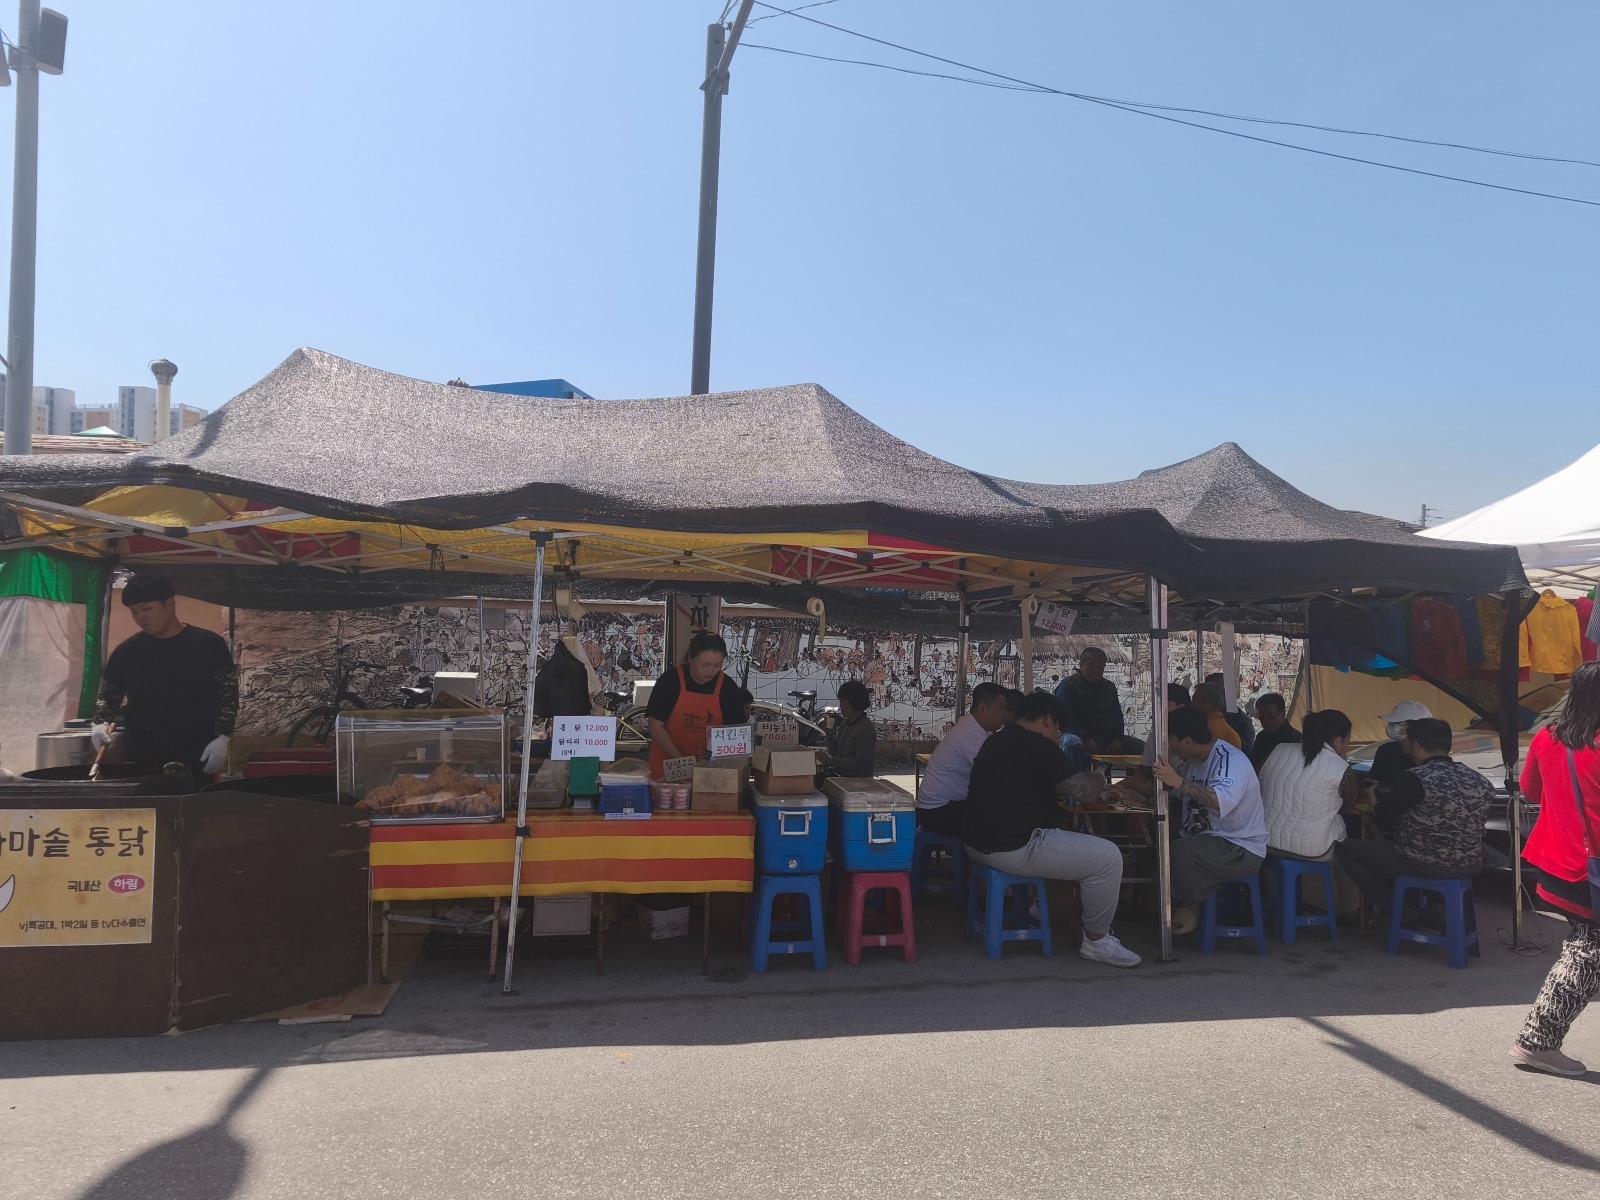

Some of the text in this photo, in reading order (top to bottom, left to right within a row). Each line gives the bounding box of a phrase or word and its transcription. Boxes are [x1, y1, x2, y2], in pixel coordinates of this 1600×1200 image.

[585, 739, 609, 747] 10,000
[716, 742, 747, 755] 500원
[665, 757, 694, 771] 양념소스
[85, 825, 149, 857] 통닭
[67, 880, 102, 892] 국내산
[113, 878, 138, 890] 하림
[60, 919, 88, 930] 1박2일
